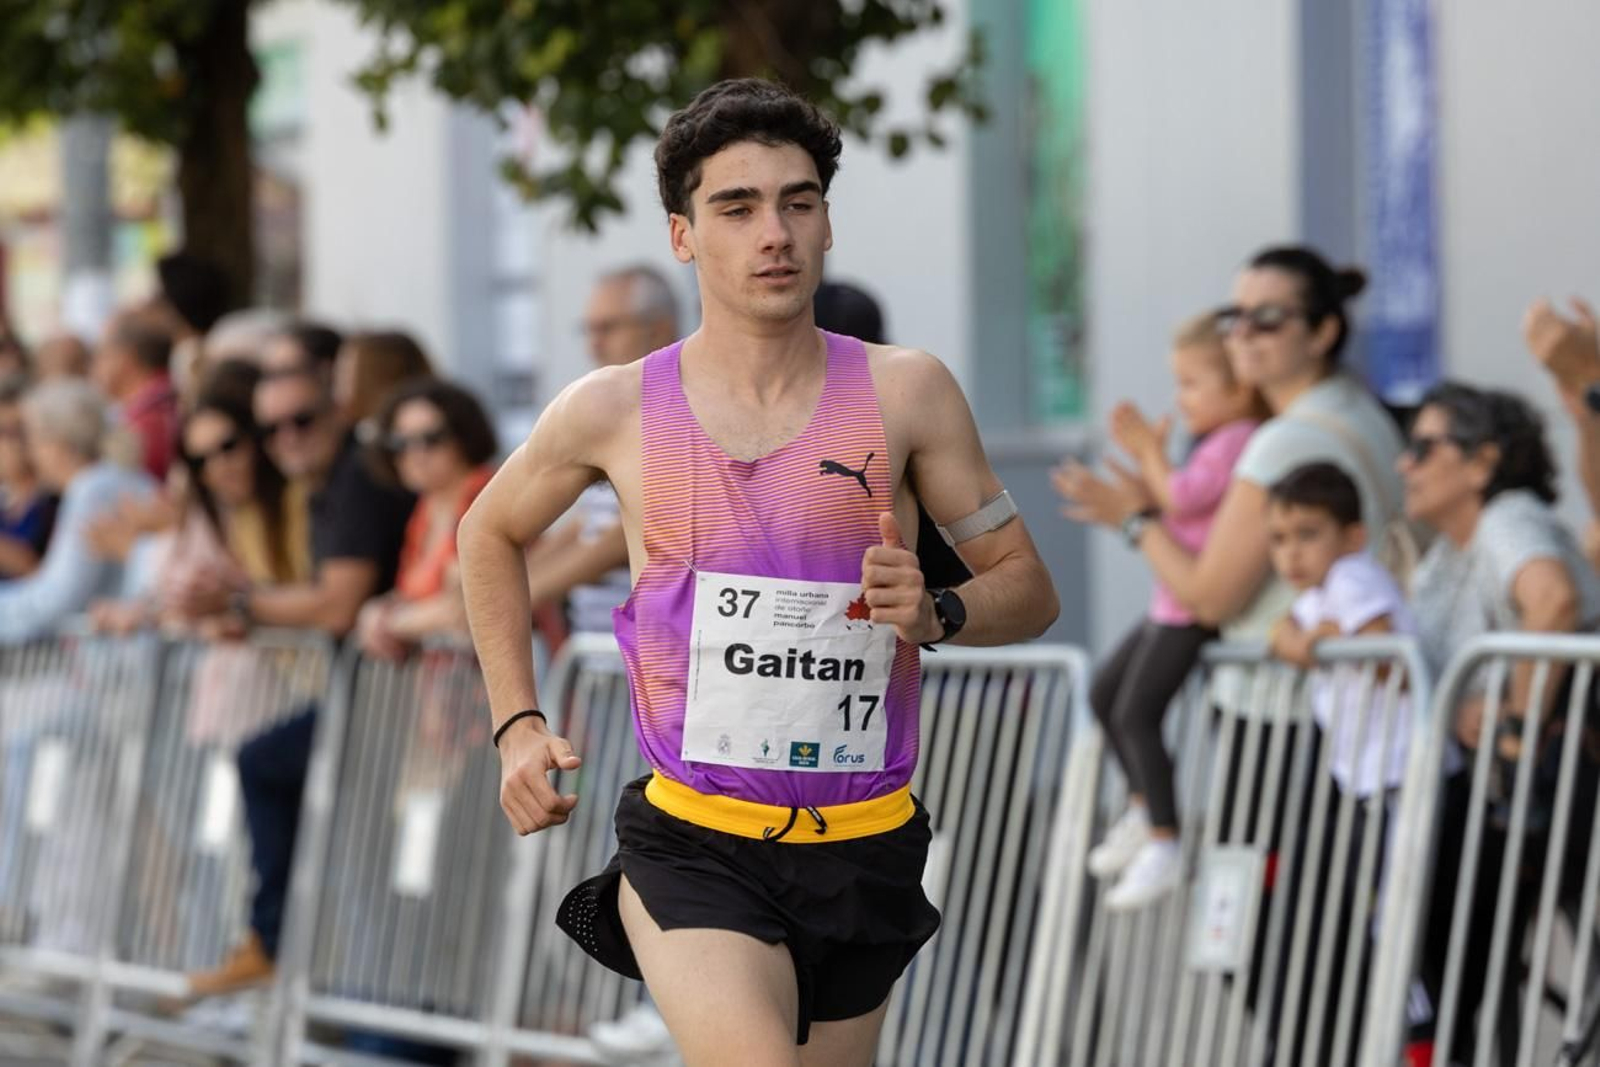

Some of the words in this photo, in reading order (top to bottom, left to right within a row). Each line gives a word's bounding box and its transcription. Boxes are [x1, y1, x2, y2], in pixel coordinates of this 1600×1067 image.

[717, 587, 761, 619] 37
[773, 620, 815, 629] pancorbo
[723, 642, 865, 681] Gaitan
[837, 694, 880, 732] 17
